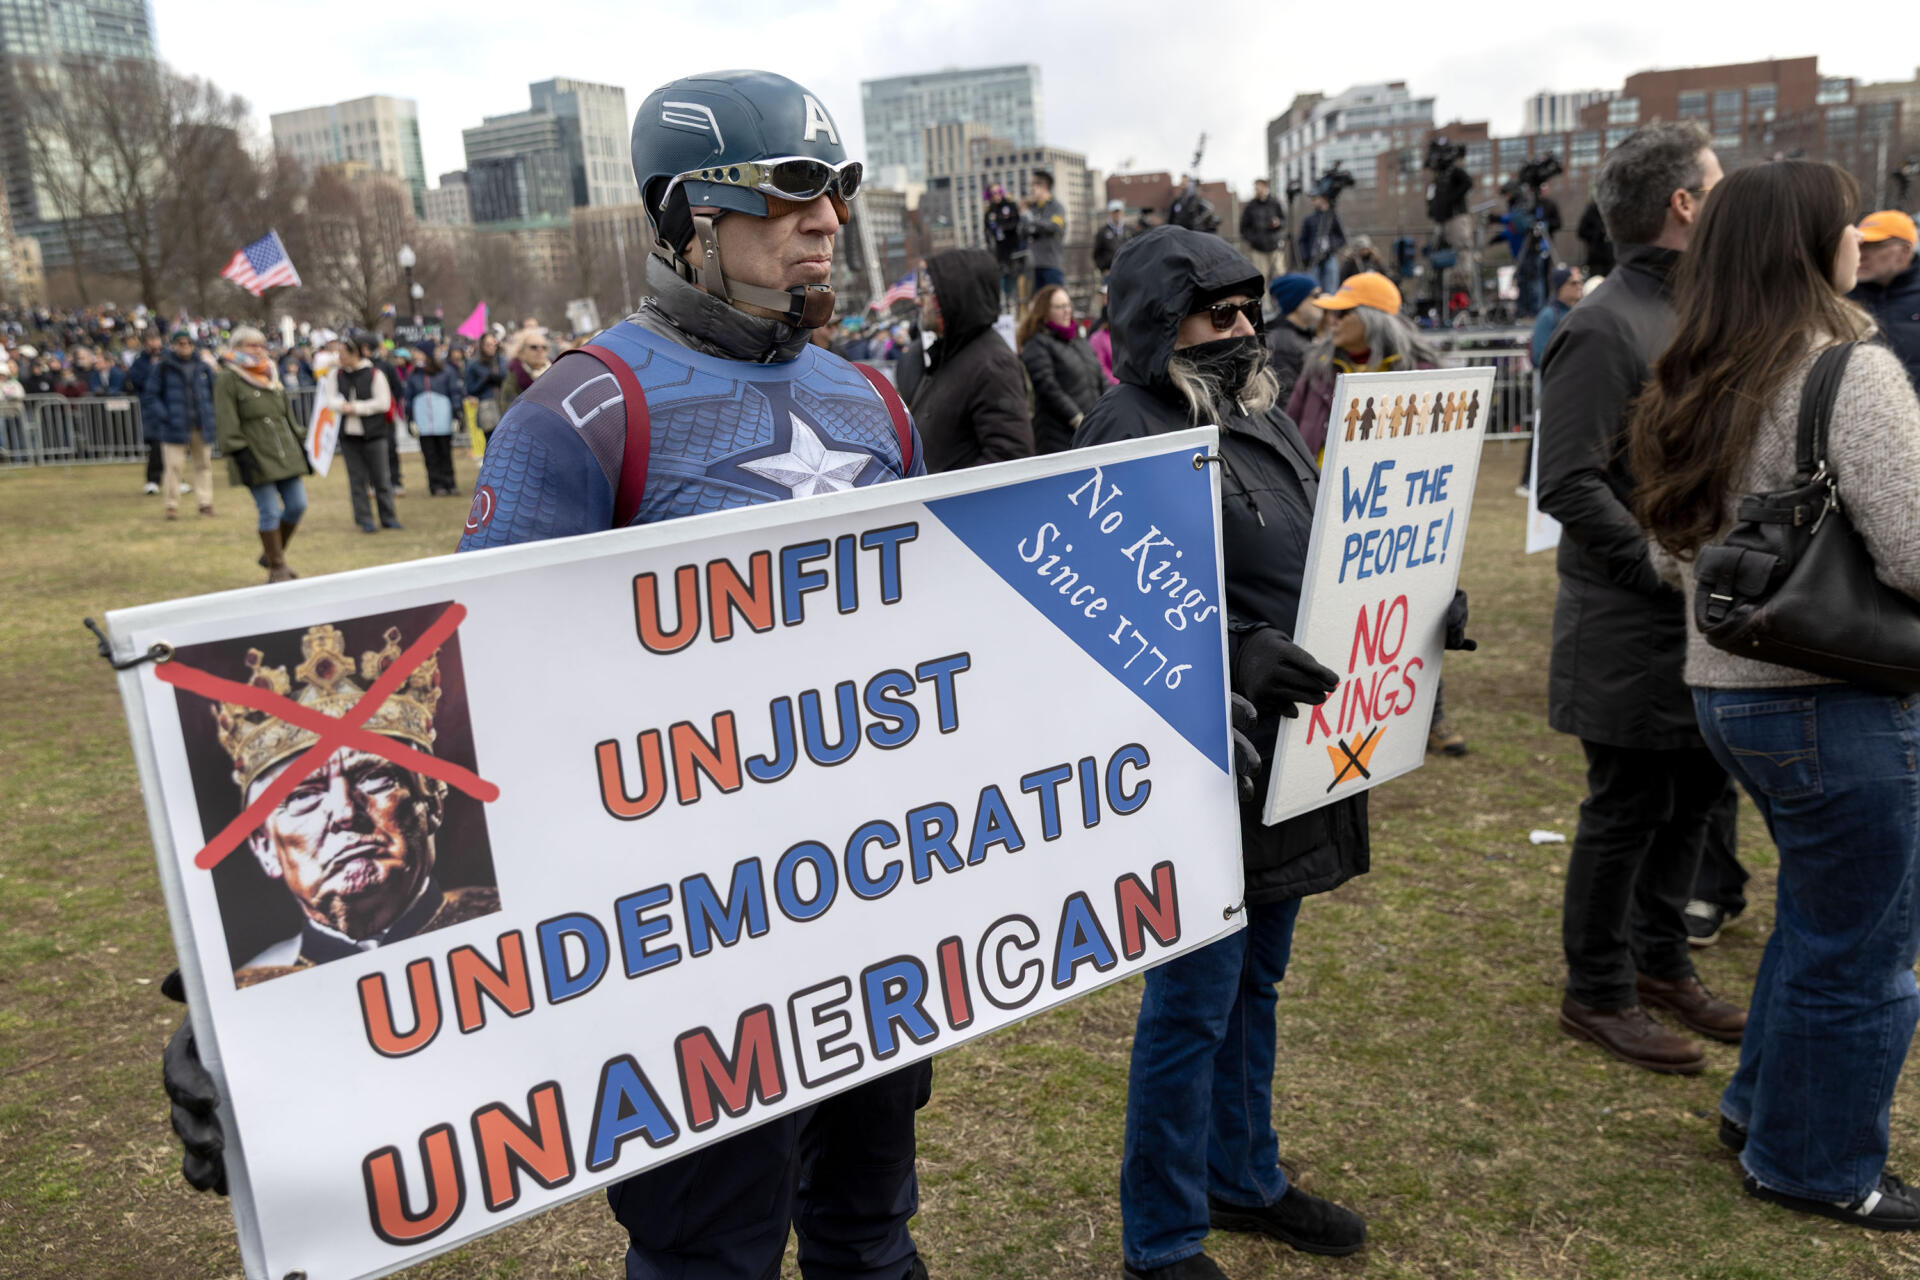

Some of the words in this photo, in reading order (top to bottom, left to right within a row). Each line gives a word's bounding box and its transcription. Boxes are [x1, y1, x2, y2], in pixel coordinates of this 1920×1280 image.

[803, 94, 839, 145] A
[1067, 465, 1124, 534] No
[1120, 525, 1218, 631] Kings
[1338, 509, 1454, 584] PEOPLE!
[1342, 460, 1396, 523] WE
[1405, 464, 1453, 507] THE
[632, 521, 919, 655] UNFIT
[1018, 523, 1107, 618] Since
[1109, 615, 1192, 689] 1776
[1348, 594, 1408, 674] NO
[594, 652, 971, 821] UNJUST
[1306, 656, 1424, 745] KINGS
[356, 743, 1153, 1060] UNDEMOCRATIC
[361, 860, 1181, 1247] UNAMERICAN
